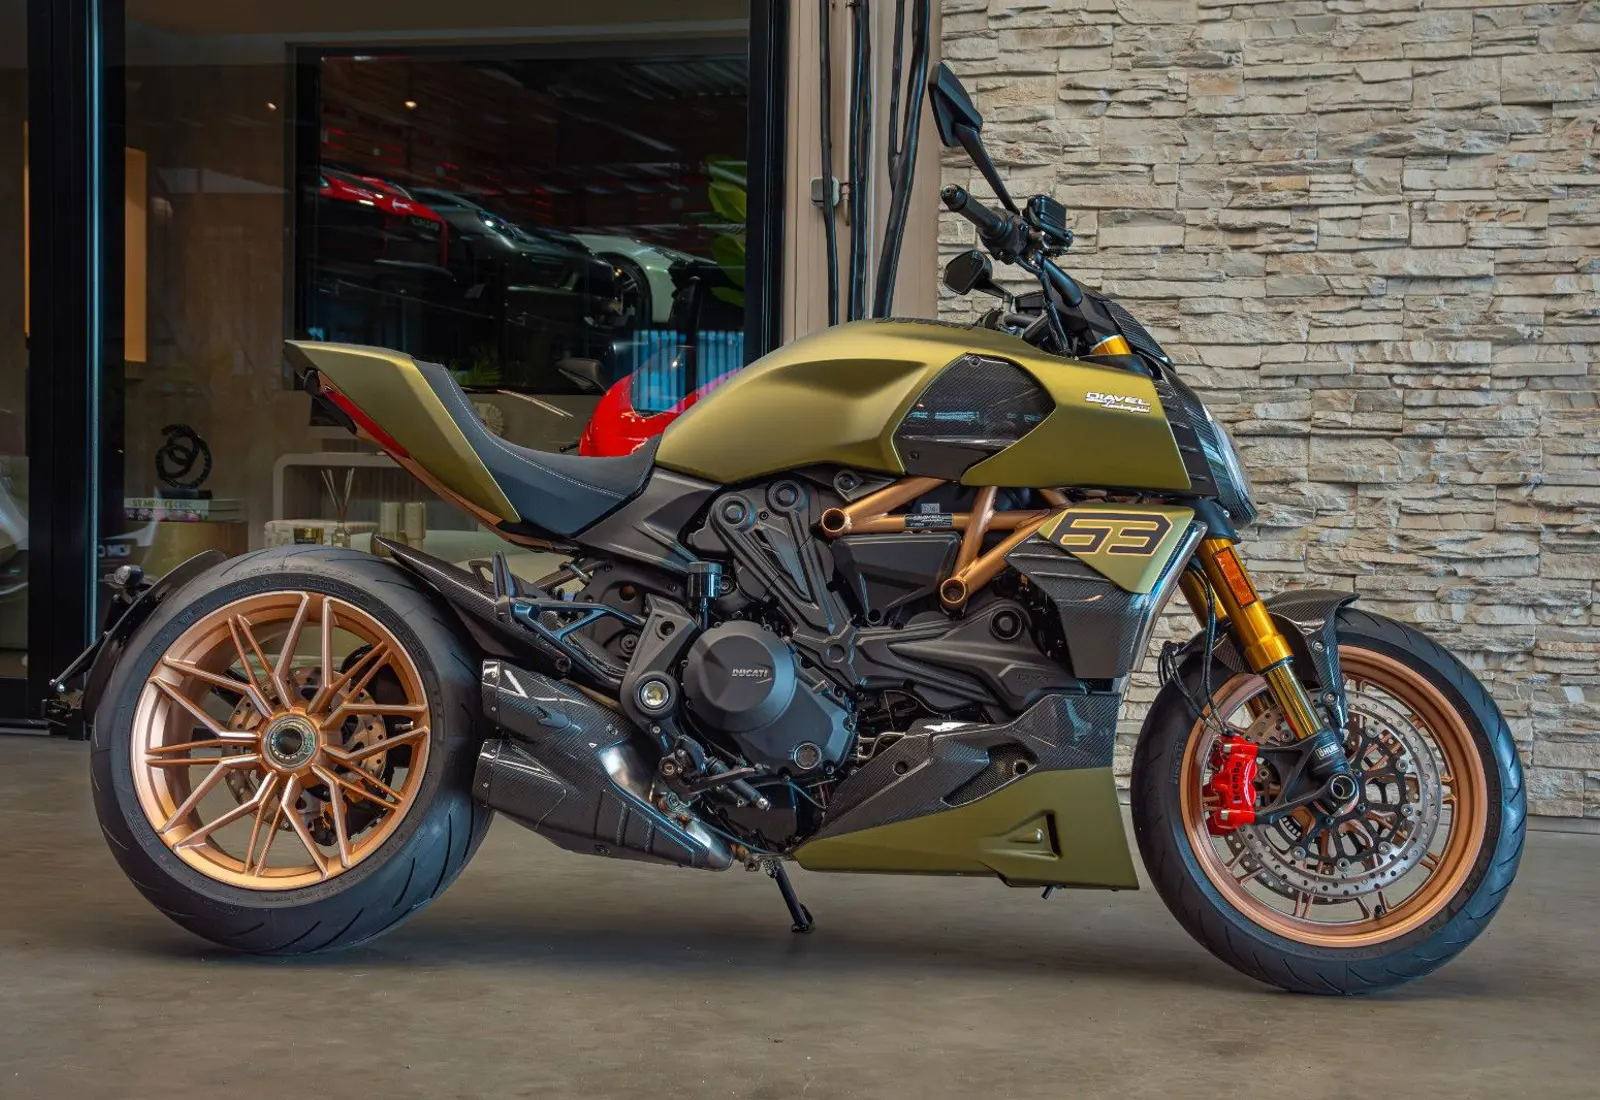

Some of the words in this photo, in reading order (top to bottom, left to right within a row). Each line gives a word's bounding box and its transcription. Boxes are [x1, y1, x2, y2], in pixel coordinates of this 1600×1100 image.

[1085, 391, 1151, 405] DIAVEL
[1048, 508, 1173, 556] 63
[731, 668, 769, 677] DUCATI
[1232, 762, 1242, 804] brembo
